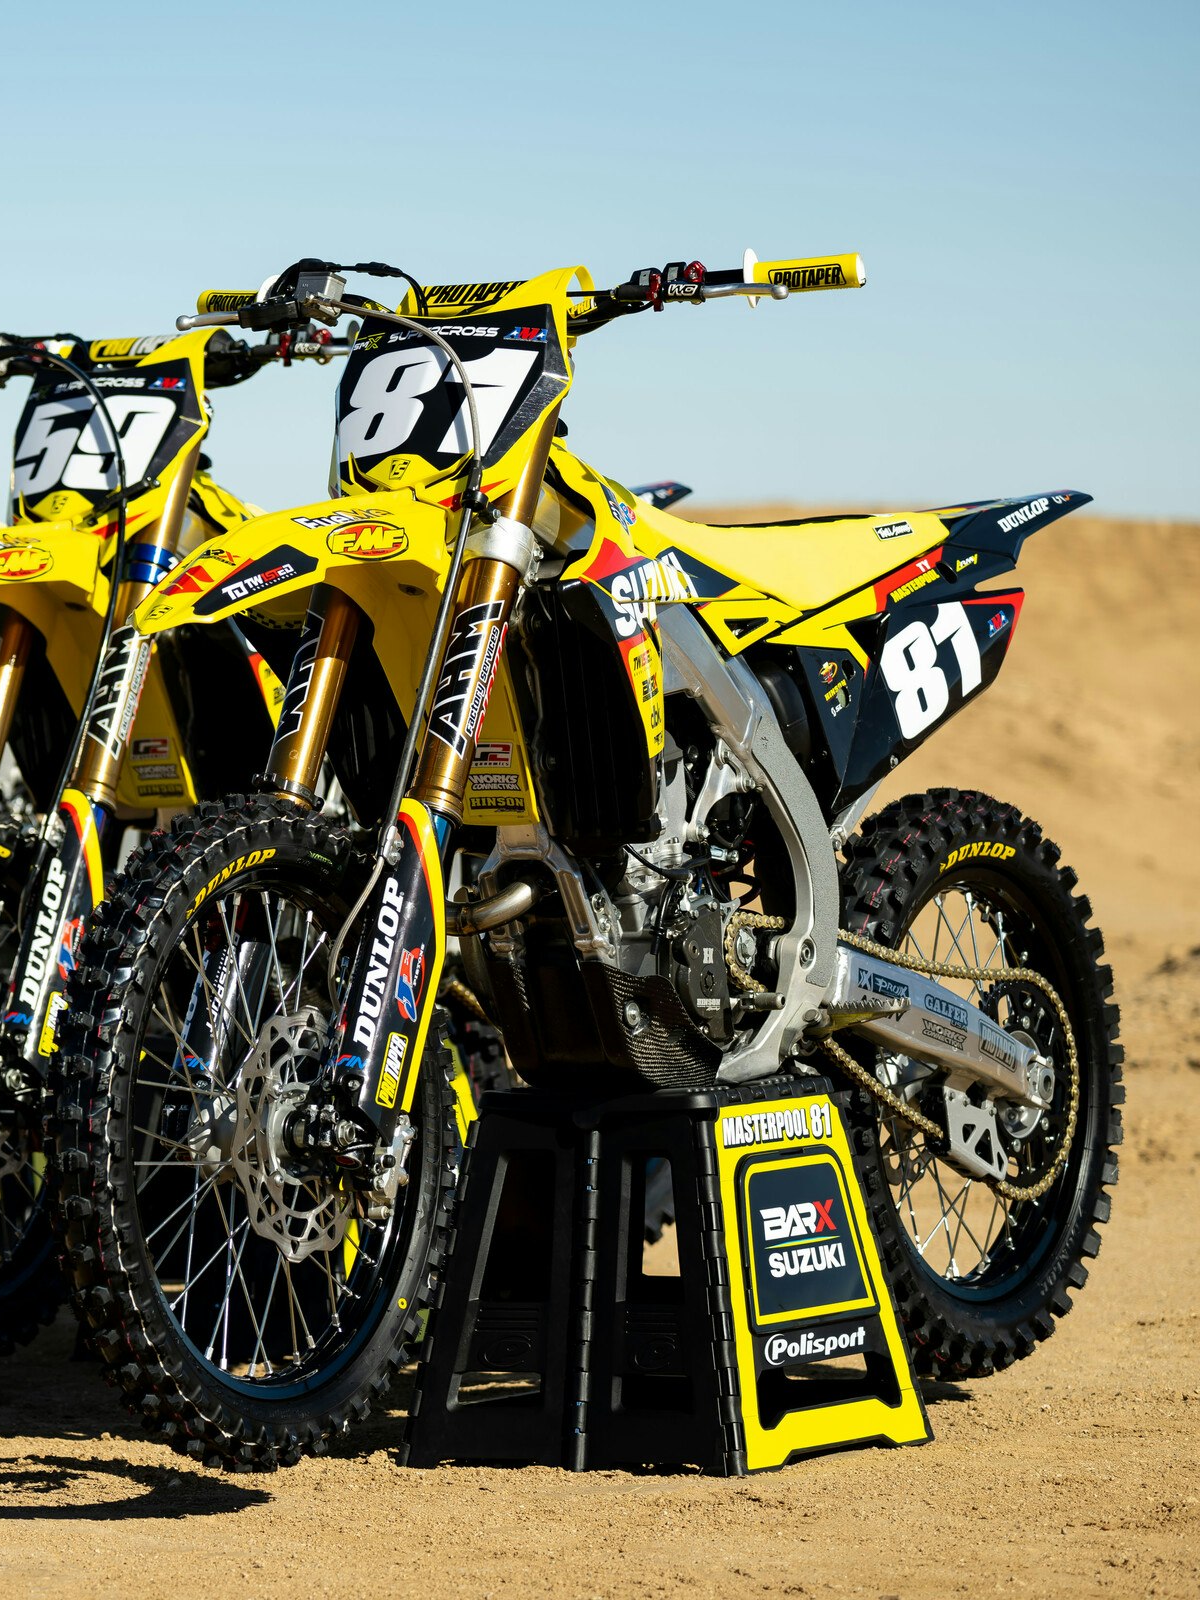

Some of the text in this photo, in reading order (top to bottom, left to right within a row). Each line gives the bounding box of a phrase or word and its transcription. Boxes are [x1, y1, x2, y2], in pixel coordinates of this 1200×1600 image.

[773, 265, 842, 290] PROTAPER
[503, 326, 548, 343] AMA
[339, 344, 539, 463] 81
[997, 497, 1049, 533] DUNLOP
[331, 526, 405, 554] FMF
[915, 559, 932, 573] TY
[890, 568, 941, 604] MASTERPOOL
[429, 600, 505, 760] AHM
[880, 600, 983, 741] 81
[468, 774, 519, 784] WORKS
[471, 797, 524, 808] HINSON
[945, 841, 1016, 870] DUNLOP
[193, 848, 277, 912] DUNLOP
[18, 856, 68, 1011] DUNLOP
[352, 876, 404, 1053] DUNLOP
[925, 994, 968, 1026] GALFER
[922, 1018, 967, 1043] WORKS
[922, 1029, 964, 1051] CONNECTION
[378, 1033, 407, 1108] PROTAPER
[722, 1103, 833, 1149] MASTERPOOL 81
[760, 1199, 834, 1241] BARX
[768, 1243, 846, 1278] SUZUKI
[768, 1327, 866, 1362] Polisport
